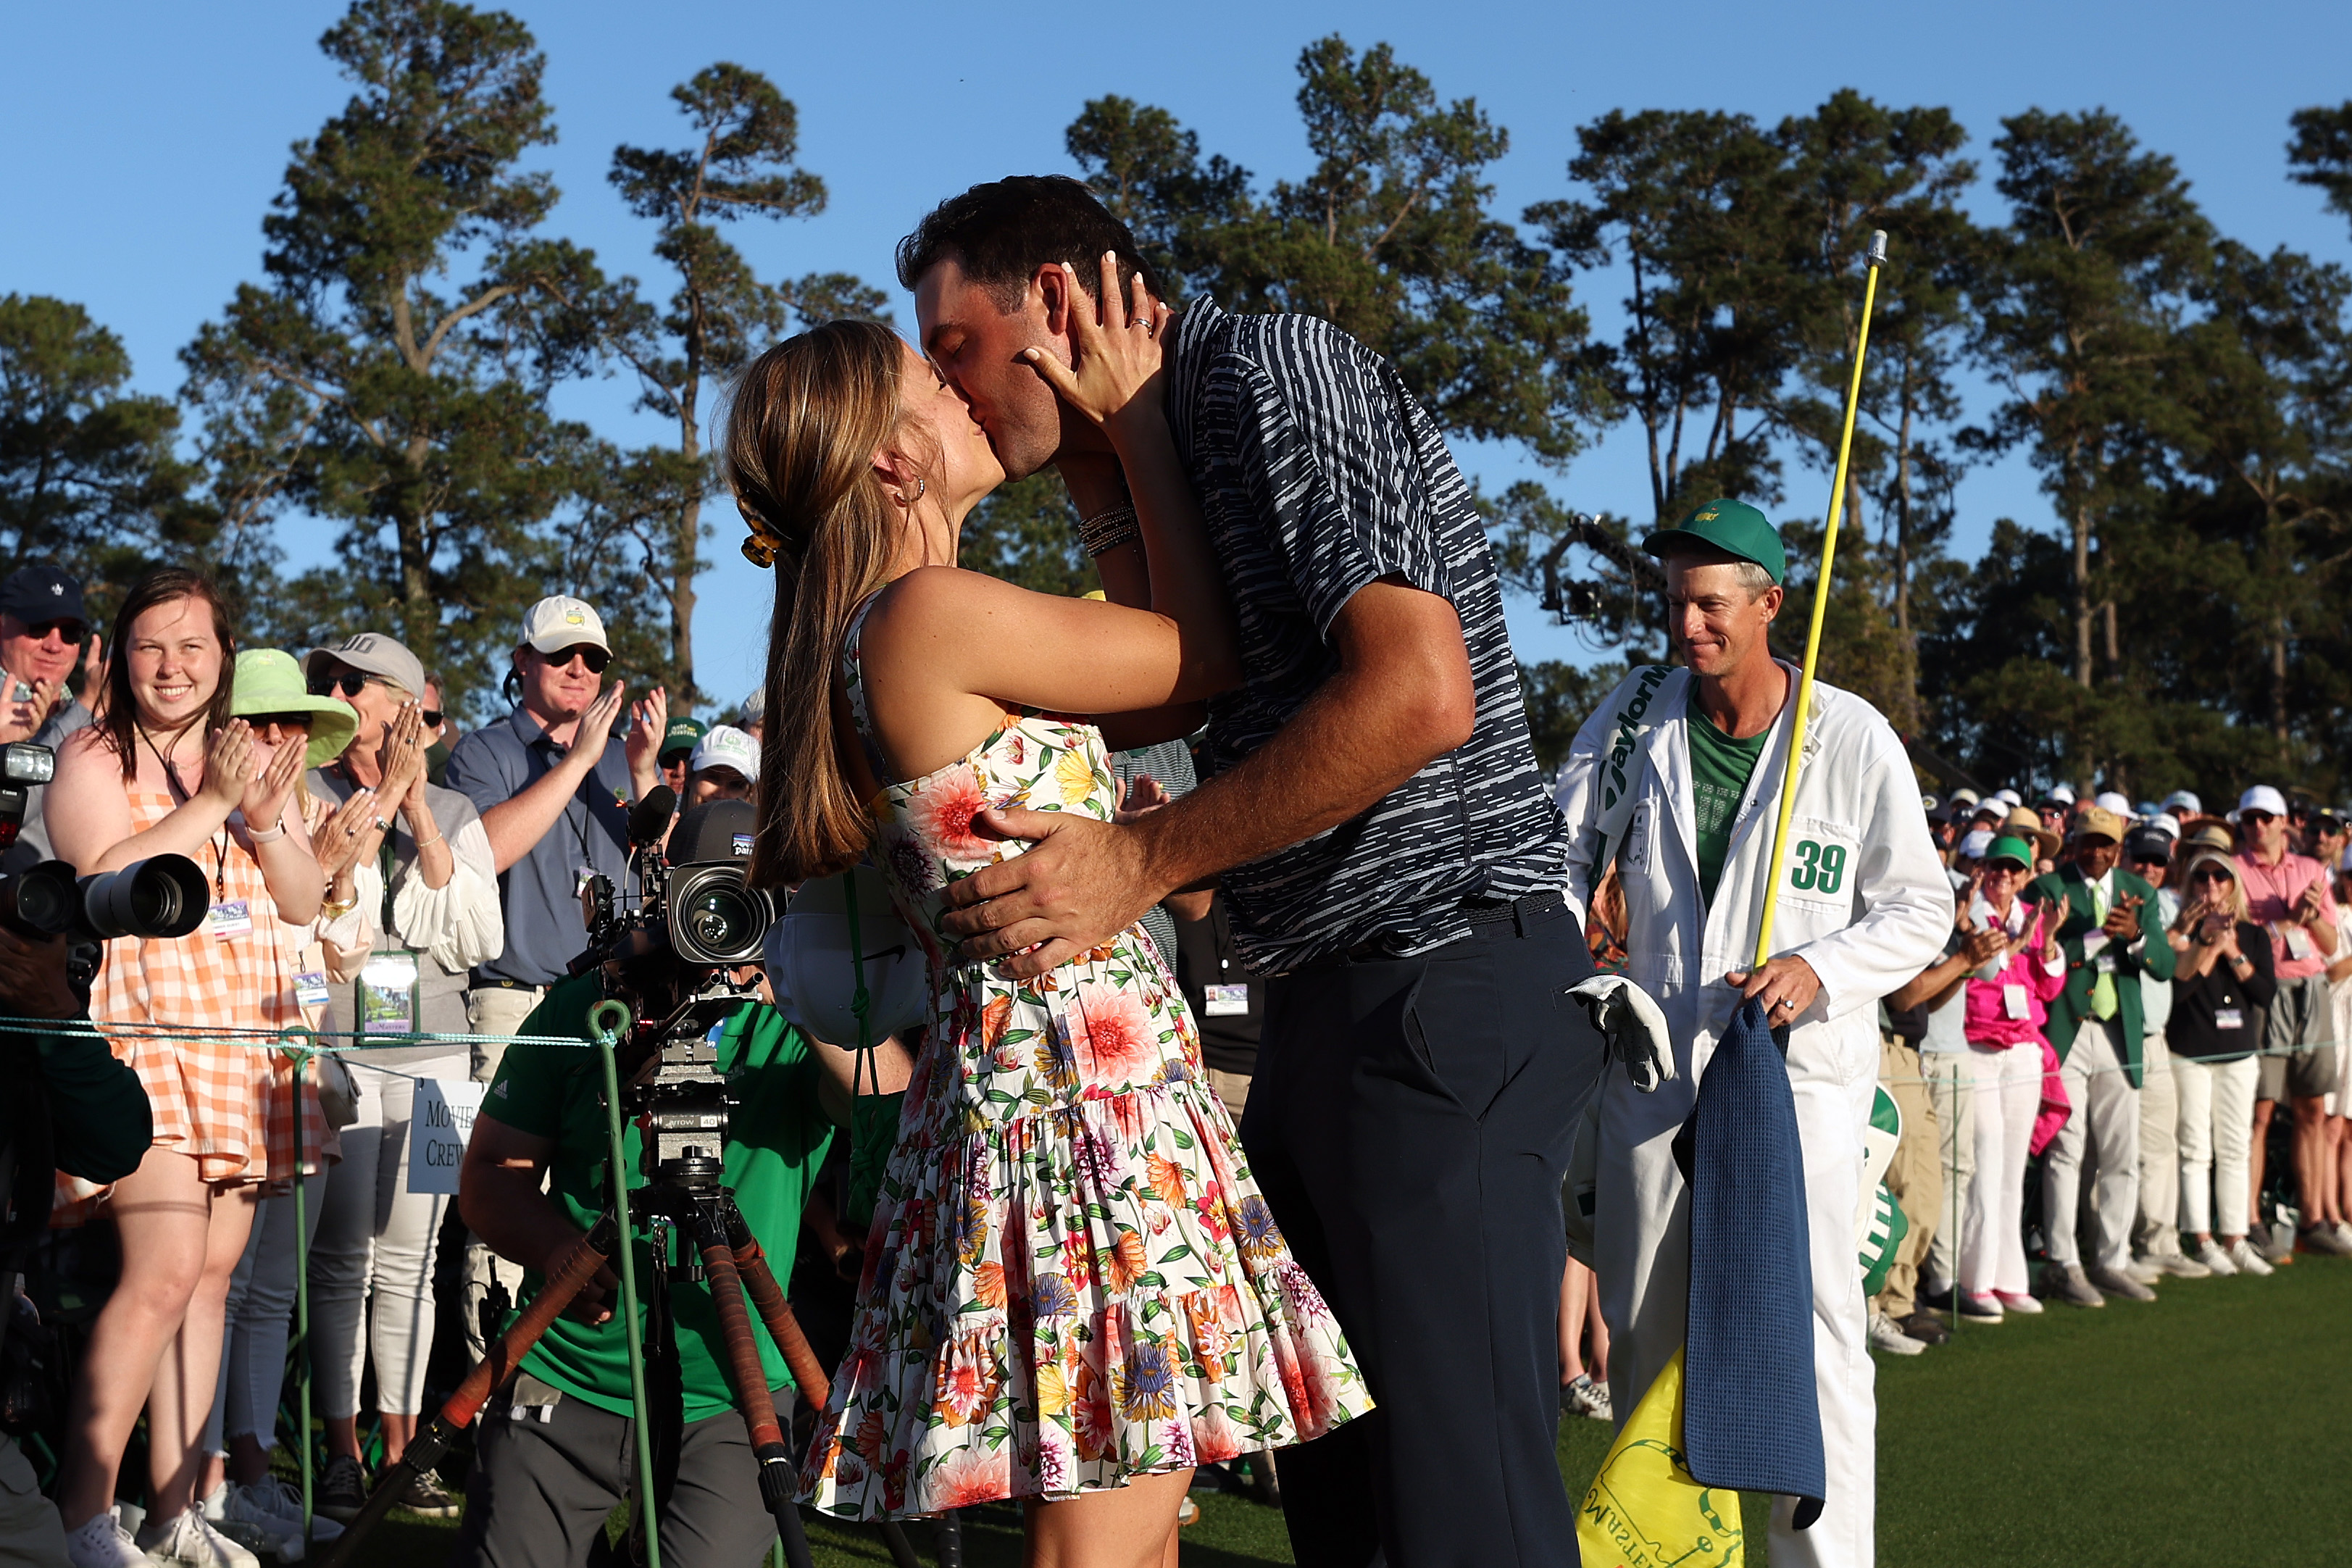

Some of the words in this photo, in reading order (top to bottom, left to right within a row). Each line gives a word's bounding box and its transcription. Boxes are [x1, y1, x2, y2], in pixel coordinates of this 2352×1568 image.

[1598, 664, 1680, 811] TaylorM
[1790, 840, 1847, 894] 39
[425, 1100, 474, 1129] MOVIE
